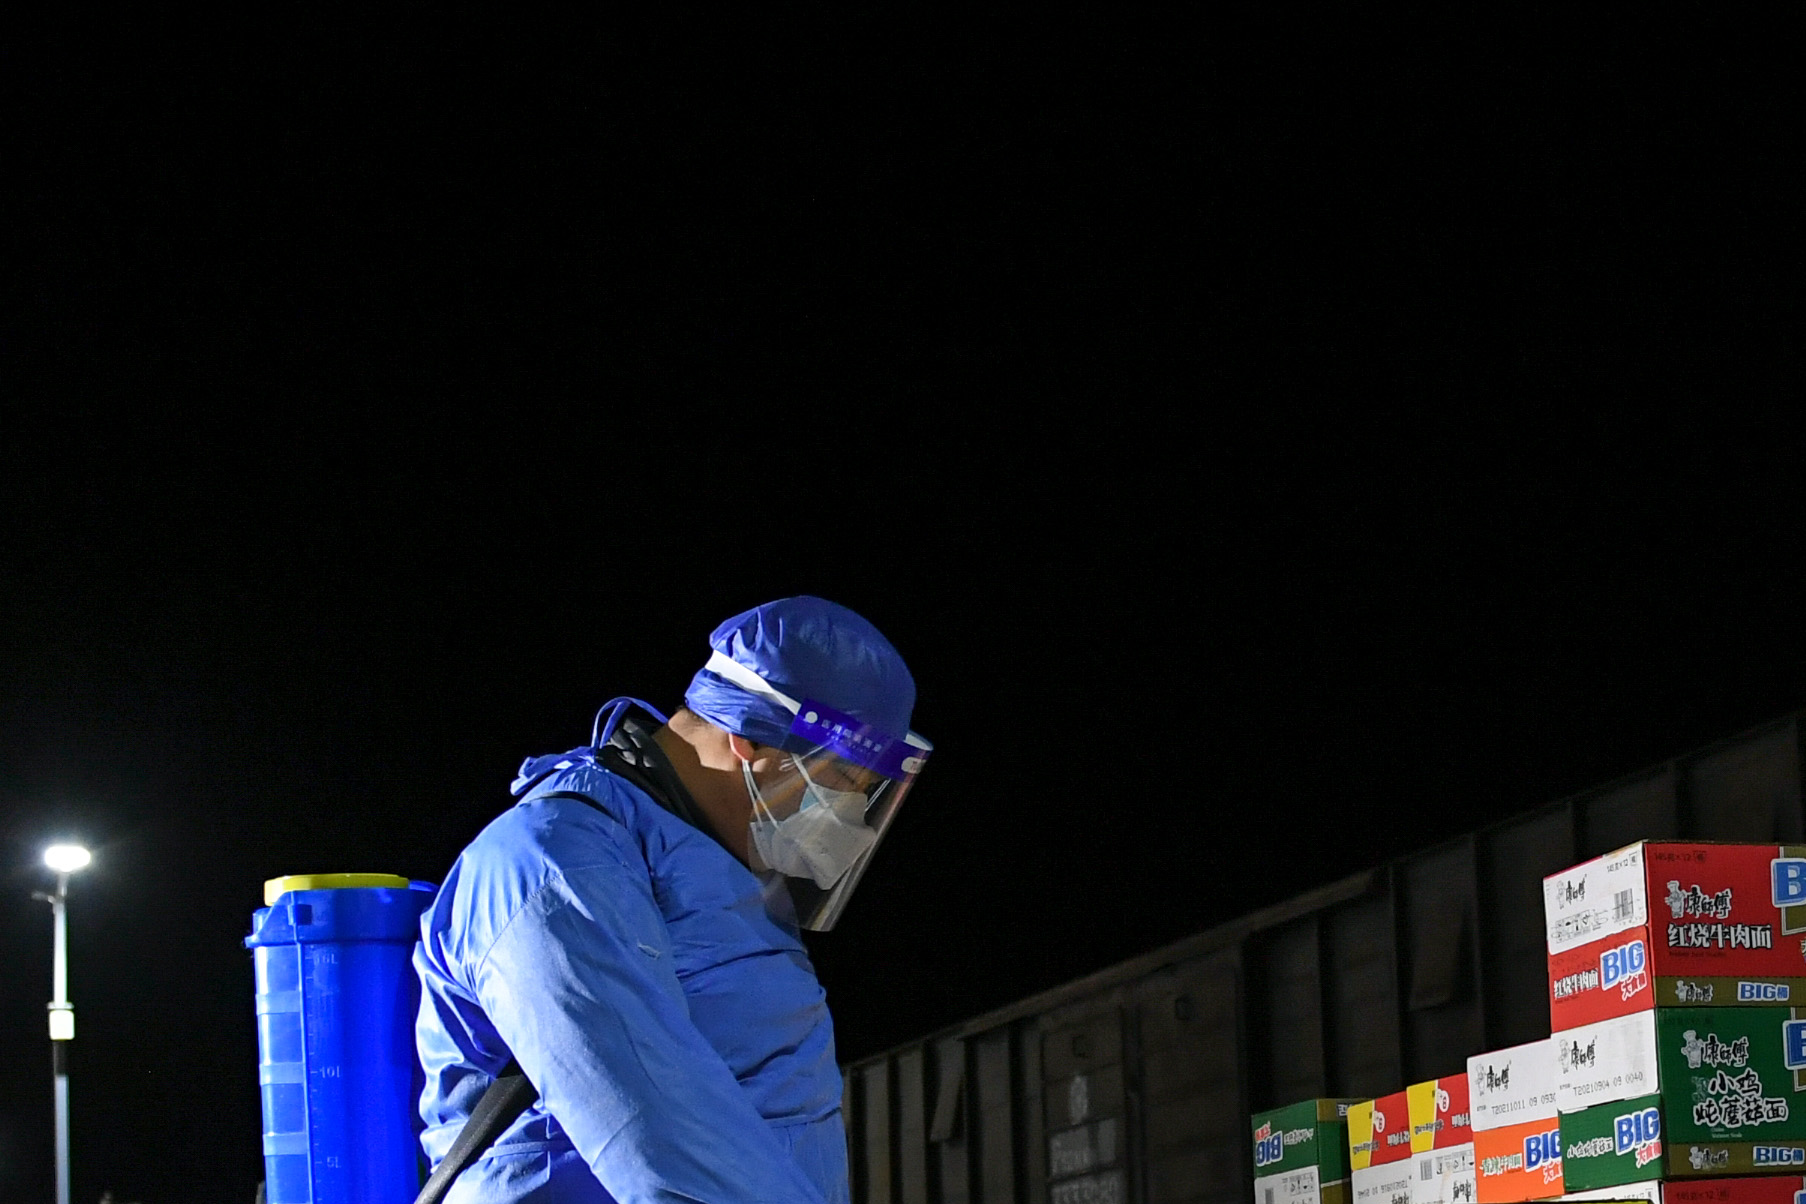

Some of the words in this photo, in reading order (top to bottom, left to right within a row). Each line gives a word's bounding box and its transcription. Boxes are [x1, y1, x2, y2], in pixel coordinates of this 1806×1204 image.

[1667, 922, 1773, 950] 红烧牛肉面
[1600, 940, 1646, 991] BIG
[1708, 1067, 1763, 1095] 小鸡
[1694, 1097, 1789, 1127] 炖蘑菇面
[1614, 1106, 1660, 1155] BIG
